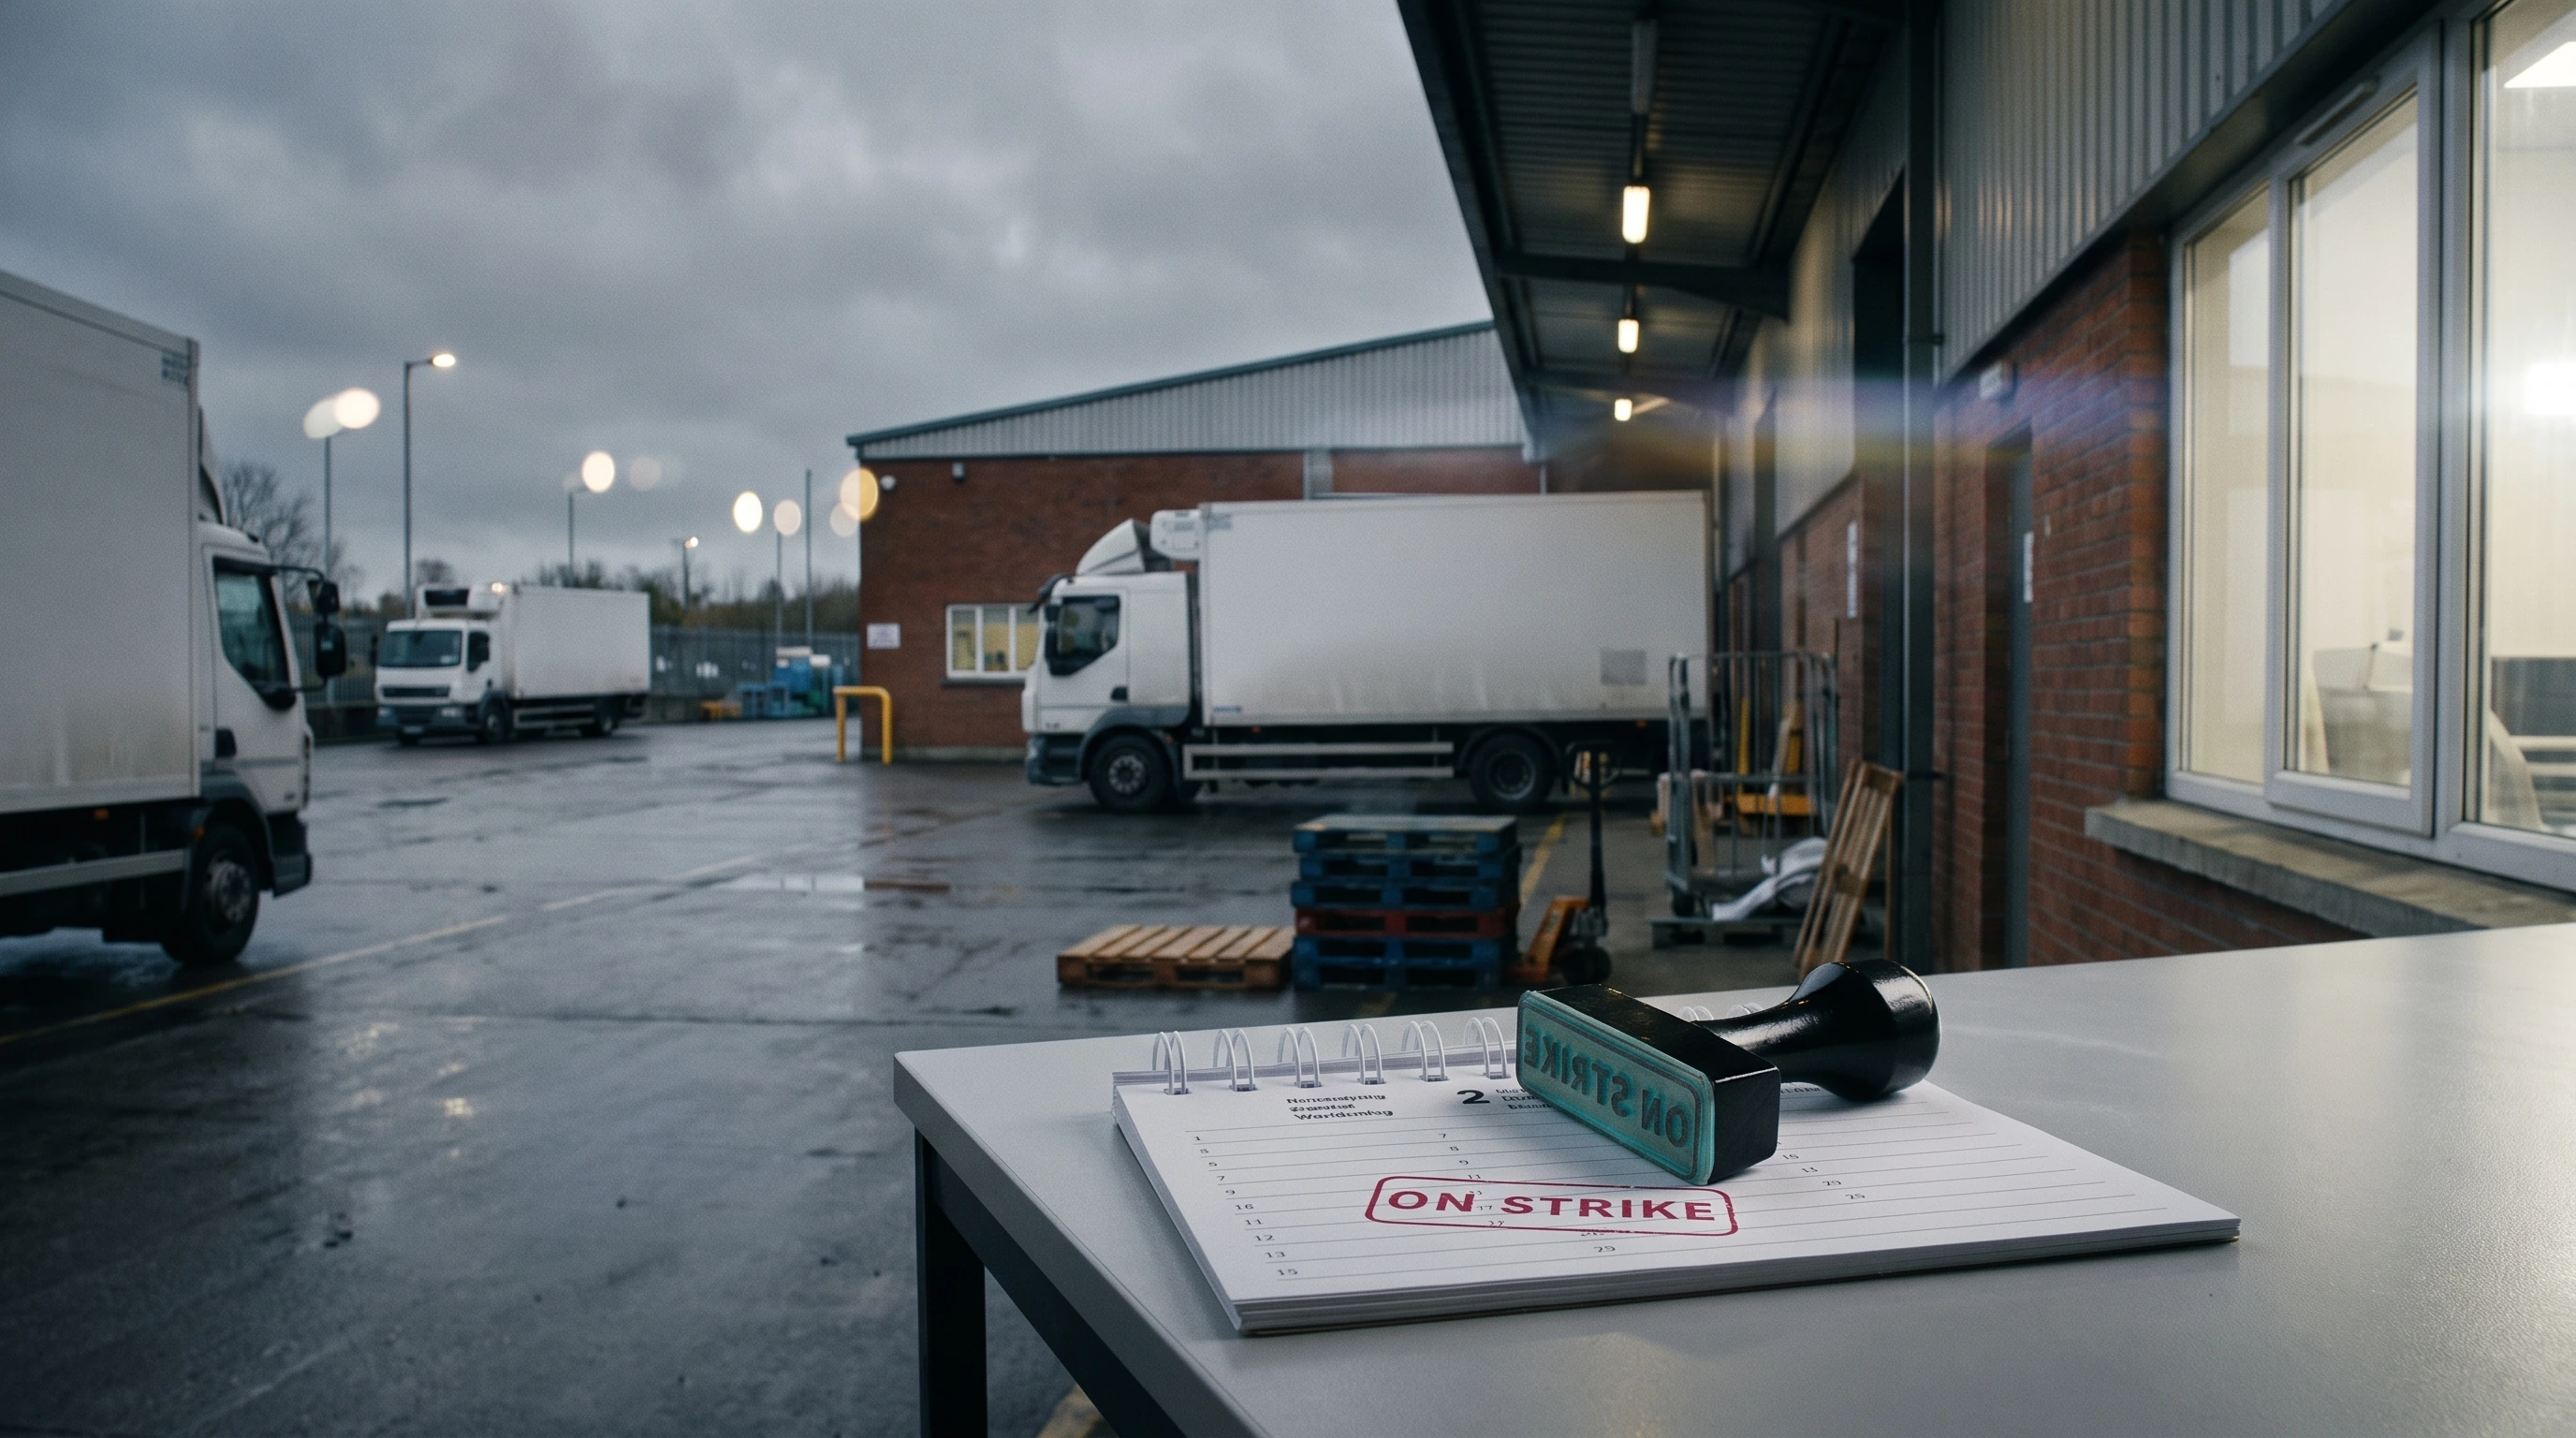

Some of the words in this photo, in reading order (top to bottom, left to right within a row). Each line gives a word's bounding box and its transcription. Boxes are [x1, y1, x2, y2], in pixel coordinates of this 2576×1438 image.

[1456, 1090, 1490, 1105] 2
[1388, 1191, 1475, 1212] ON
[1500, 1196, 1717, 1222] STRIKE
